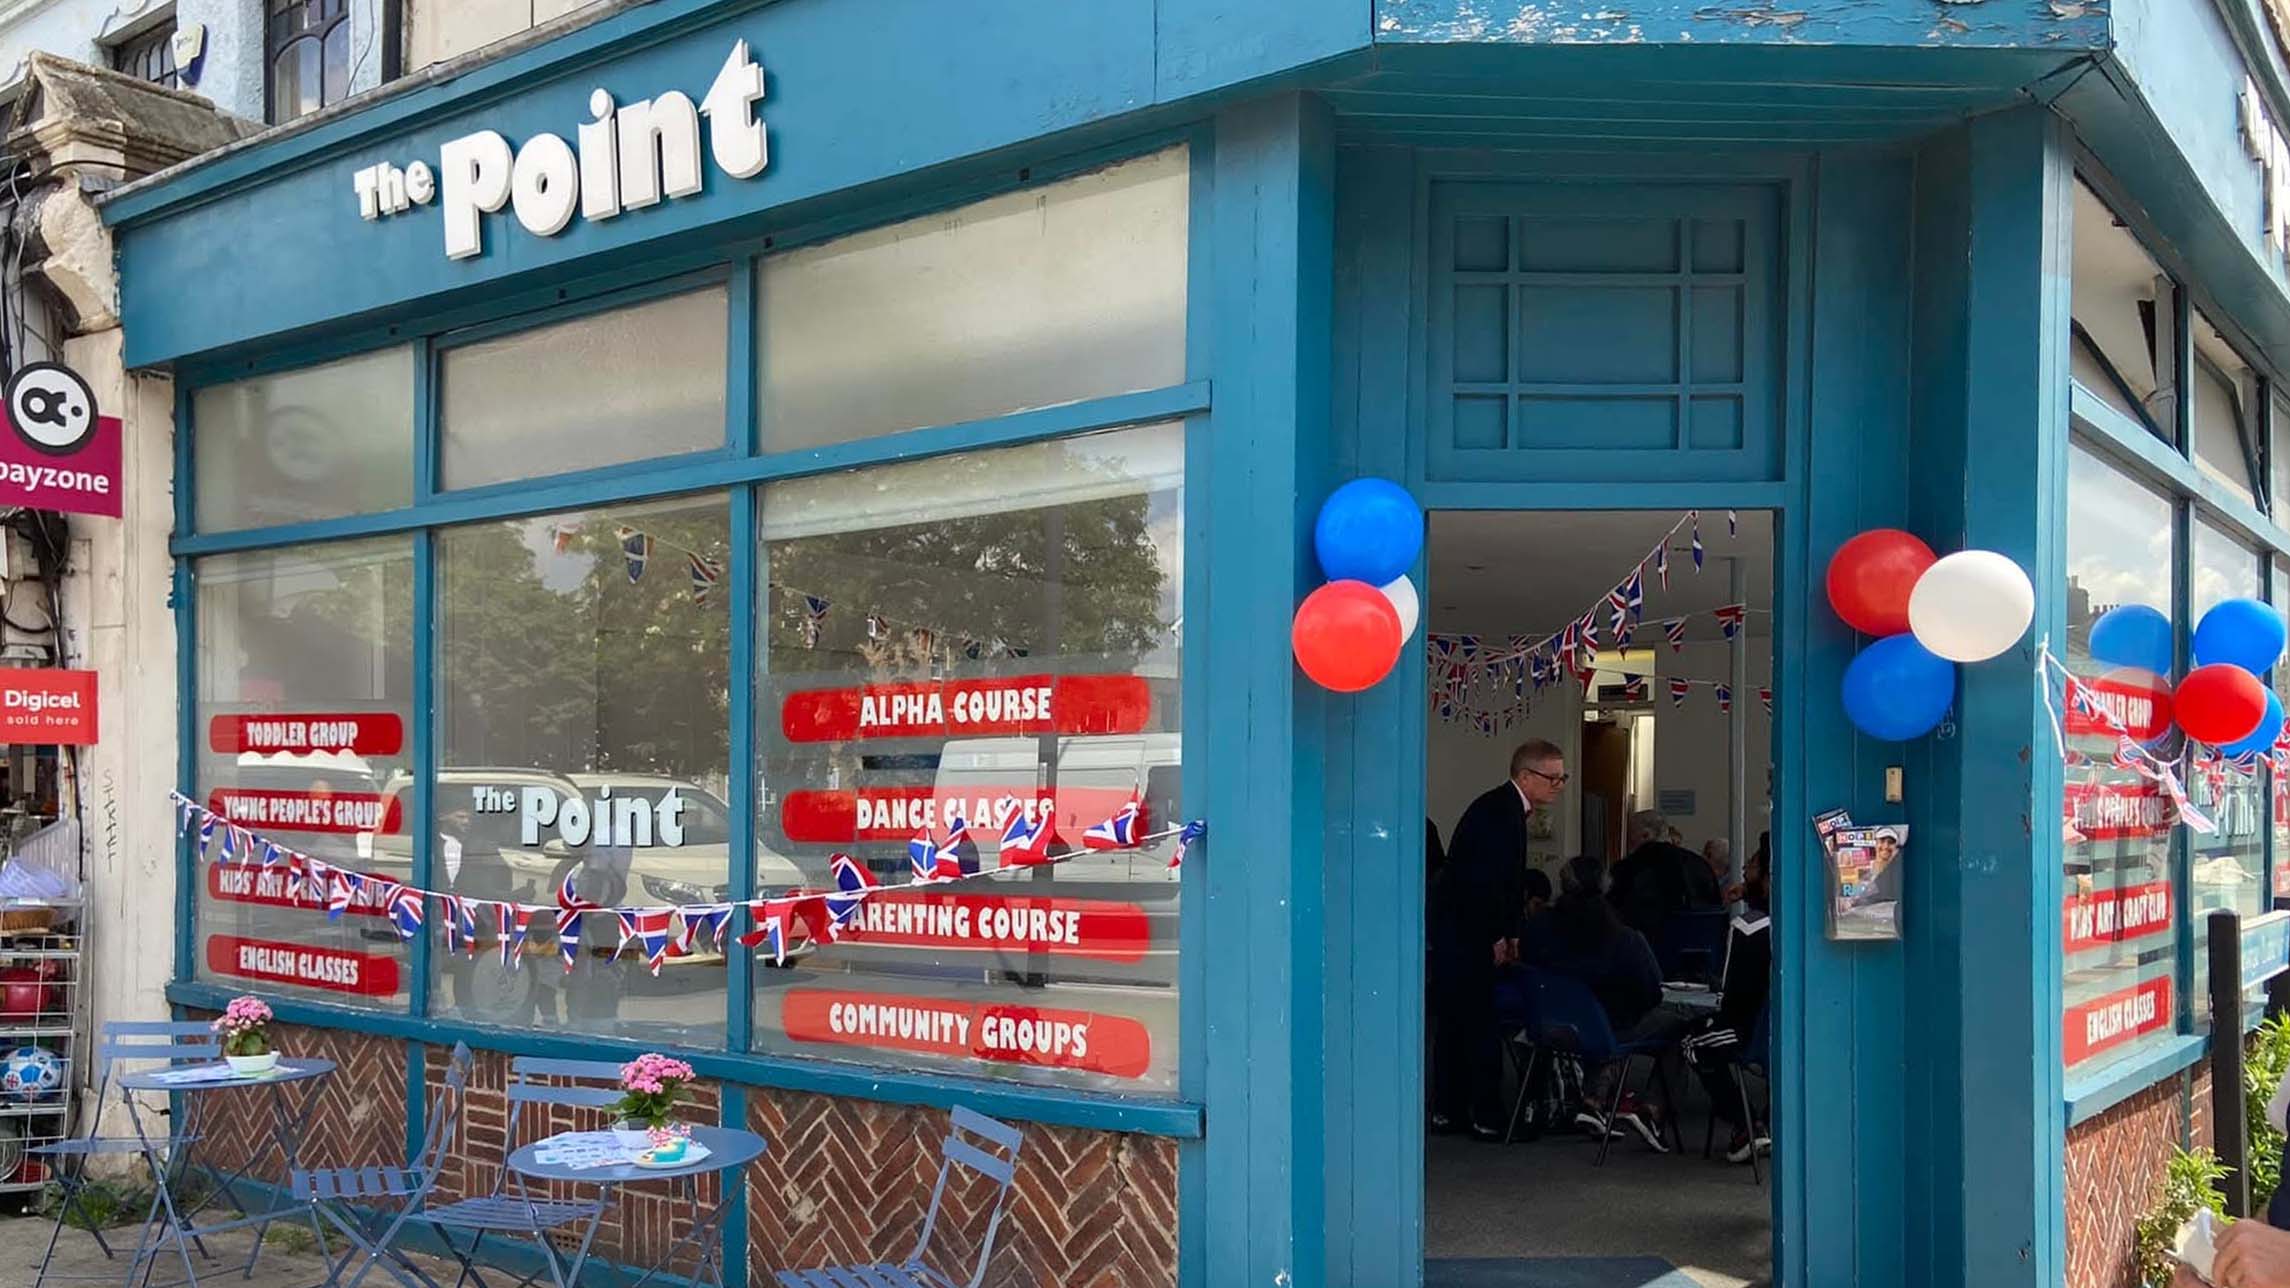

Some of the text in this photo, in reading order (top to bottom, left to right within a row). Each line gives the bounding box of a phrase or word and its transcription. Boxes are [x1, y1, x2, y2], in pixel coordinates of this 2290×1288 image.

[353, 37, 770, 261] The Point
[5, 690, 81, 712] Digicel
[6, 714, 79, 727] sold here
[859, 686, 1053, 728] ALPHA COURSE
[246, 721, 359, 748] TODDLER GROUP
[223, 796, 384, 829] YOUNG PEOPLE'S GROUP
[472, 783, 686, 848] The Point
[856, 798, 937, 830] DANCE
[848, 902, 1081, 945] ARENTING COURSE
[240, 945, 359, 985] ENGLISH CLASSES
[829, 1001, 1088, 1058] COMMUNITY GROUPS
